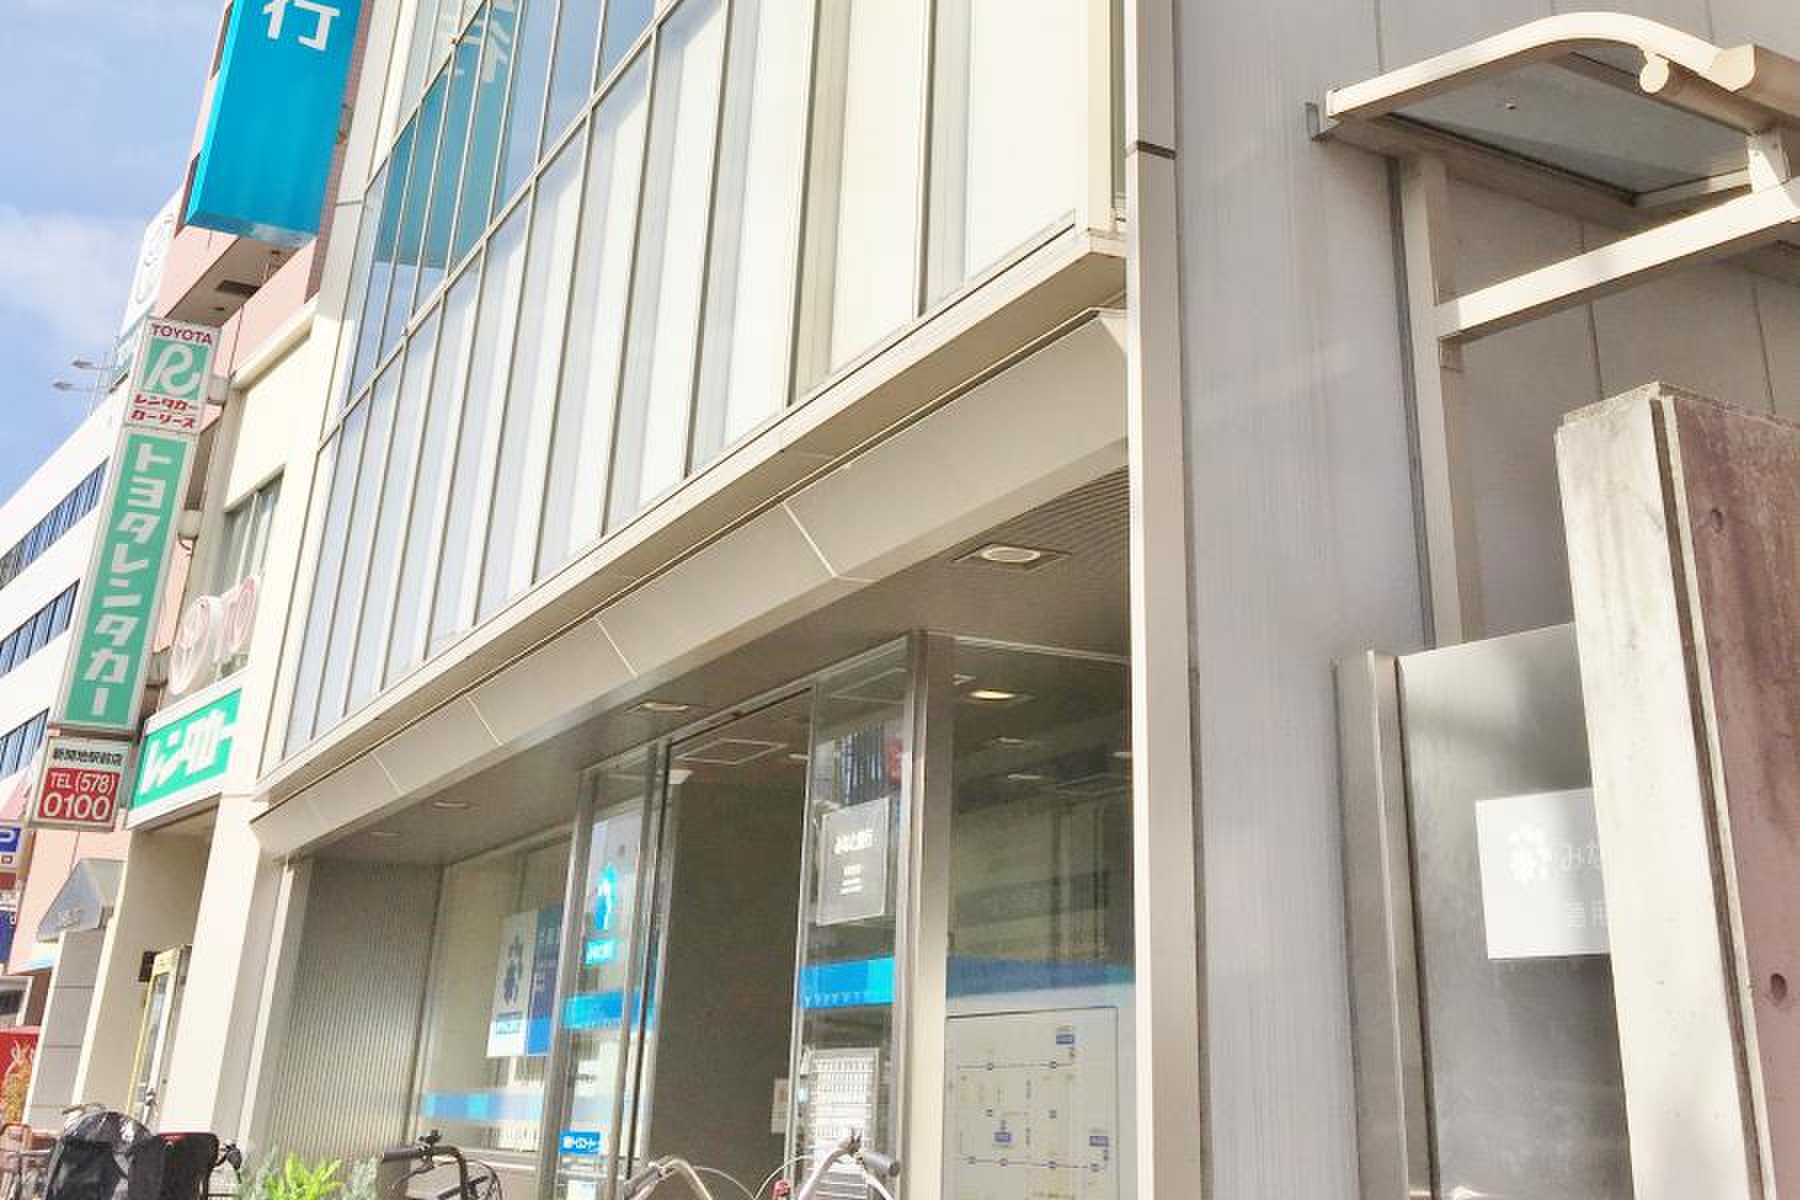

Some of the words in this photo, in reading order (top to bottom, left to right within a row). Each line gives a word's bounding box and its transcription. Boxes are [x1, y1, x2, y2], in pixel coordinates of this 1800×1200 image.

[151, 322, 213, 345] TOYOTA
[134, 394, 198, 411] レンタカー
[131, 409, 195, 429] カーリース
[83, 442, 171, 717] トヨタレンタカー
[50, 772, 73, 789] TEL
[74, 771, 114, 797] (578)
[43, 791, 110, 820] 0100
